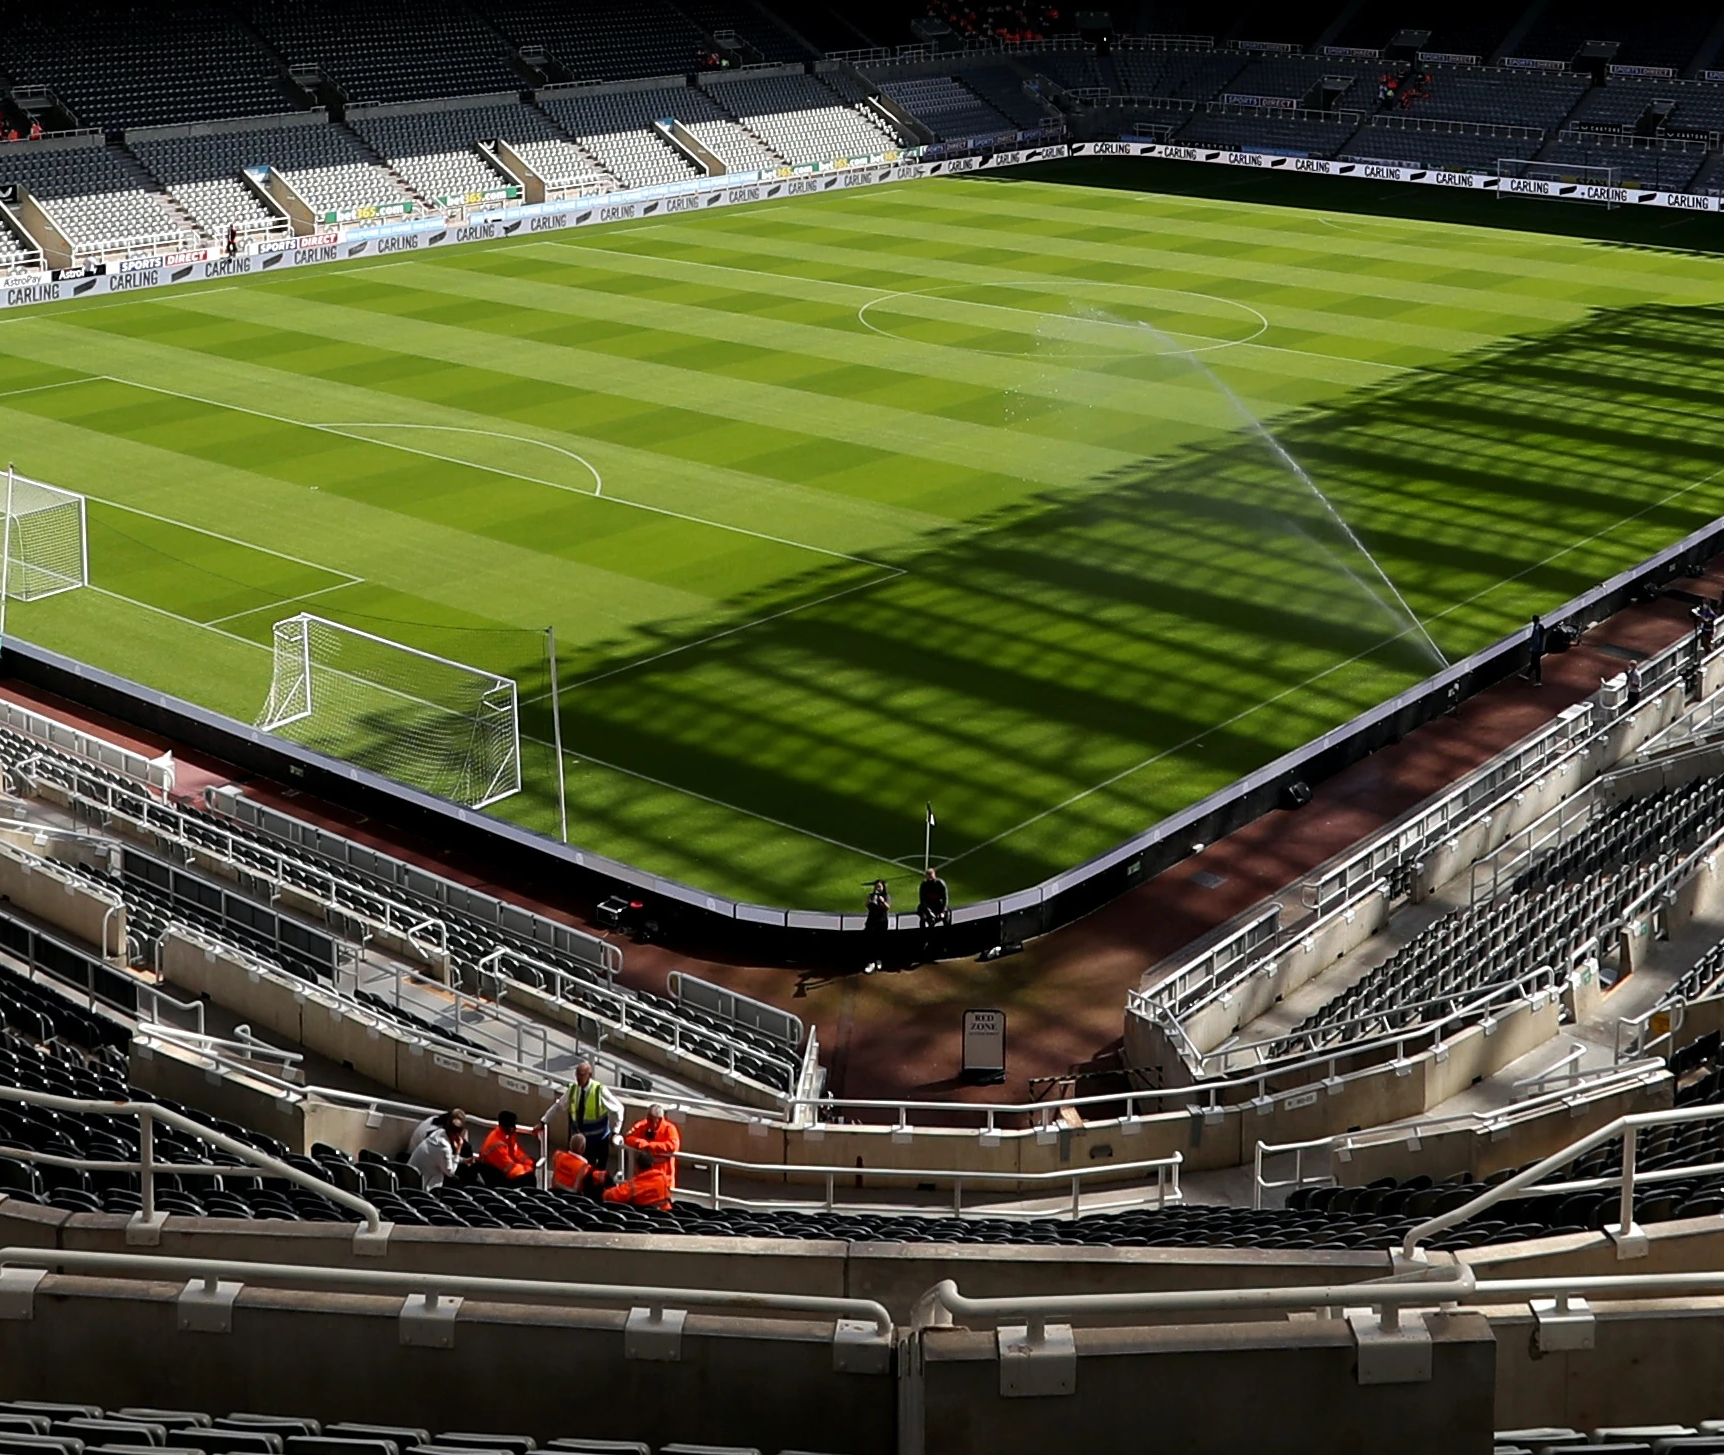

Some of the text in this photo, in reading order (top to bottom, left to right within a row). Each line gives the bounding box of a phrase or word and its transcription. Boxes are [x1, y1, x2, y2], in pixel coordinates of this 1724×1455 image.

[1228, 95, 1294, 107] SPORTS DIRECT
[1041, 146, 1065, 158] CARLING
[1093, 143, 1130, 154] CARLING
[1164, 148, 1197, 159] CARLING
[948, 158, 973, 172] CARLING
[995, 155, 1020, 167] CARLING
[1228, 153, 1262, 166] CARLING
[1295, 159, 1330, 172] CARLING
[844, 172, 873, 186] CARLING
[1364, 166, 1400, 179] CARLING
[1436, 173, 1473, 186] CARLING
[788, 179, 817, 194] CARLING
[1510, 179, 1549, 193] CARLING
[446, 188, 507, 206] bet365.com
[729, 188, 760, 203] CARLING
[1587, 187, 1628, 201] CARLING
[667, 196, 700, 212] CARLING
[1667, 195, 1709, 209] CARLING
[336, 203, 404, 222] bet365.com
[600, 204, 635, 221] CARLING
[530, 214, 567, 230] CARLING
[456, 223, 494, 242] CARLING
[260, 234, 338, 253] SPORTS DIRECT
[378, 234, 418, 254] CARLING
[121, 250, 206, 272] SPORTS DIRECT
[294, 245, 337, 264] CARLING
[205, 257, 251, 278] CARLING
[3, 275, 43, 287] AstroPay
[109, 271, 158, 291] CARLING
[8, 284, 60, 305] CARLING
[975, 1014, 994, 1022] RED
[970, 1023, 996, 1031] ZONE
